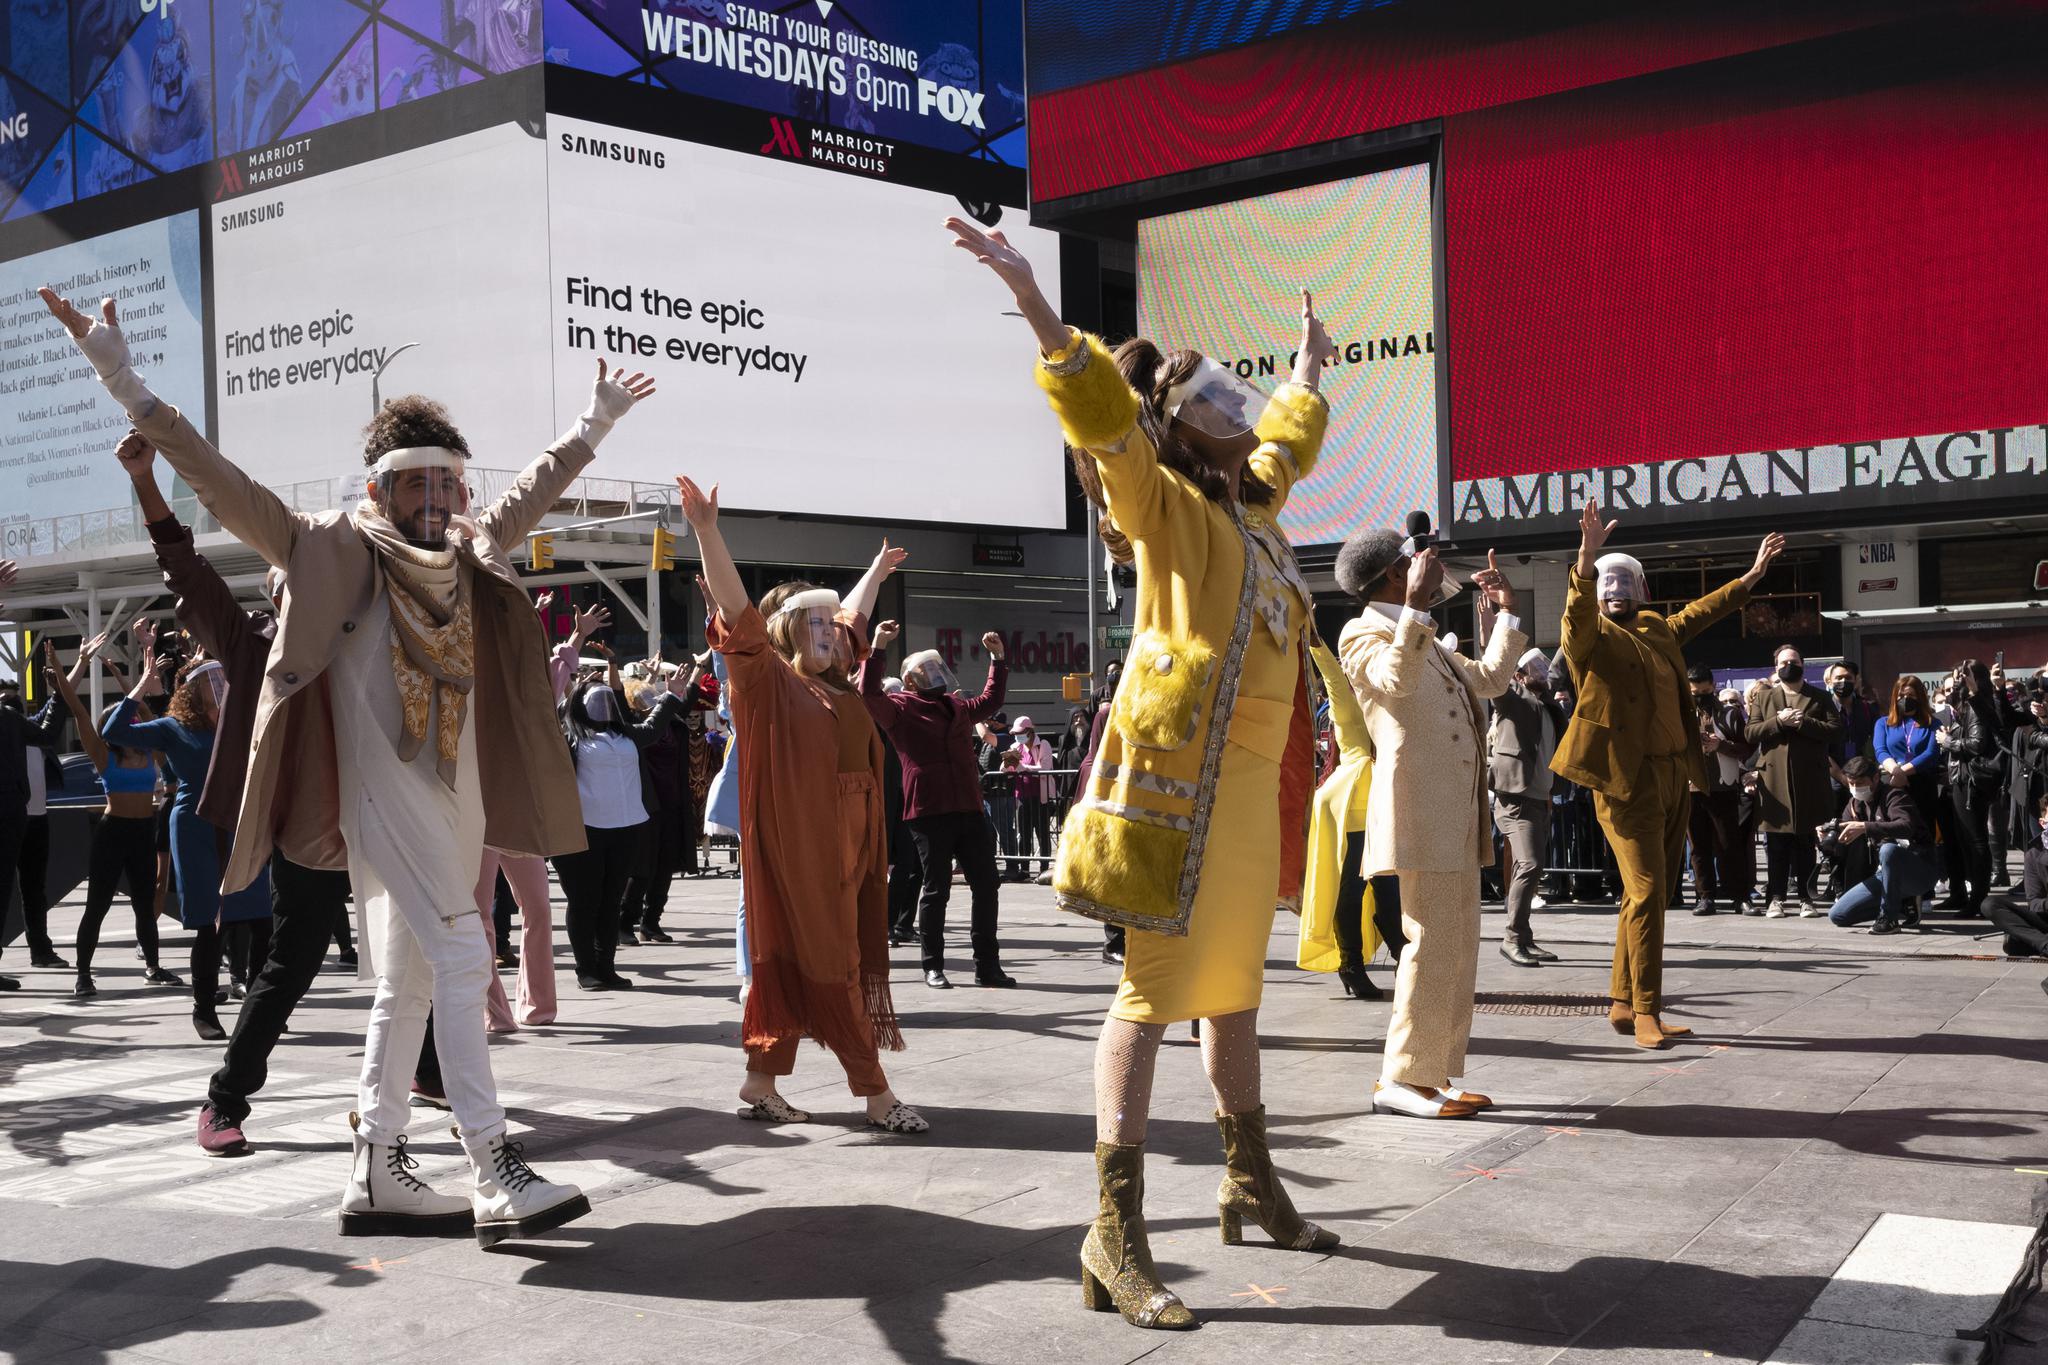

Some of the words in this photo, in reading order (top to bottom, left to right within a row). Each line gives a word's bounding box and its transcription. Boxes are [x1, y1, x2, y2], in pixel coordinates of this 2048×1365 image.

[726, 2, 780, 37] START
[784, 17, 831, 50] YOUR
[836, 31, 918, 72] GUESSING
[641, 8, 847, 96] WEDNESDAYS
[855, 62, 910, 113] 8pm
[918, 78, 986, 130] FOX
[248, 138, 312, 168] MARRIOTT
[561, 132, 667, 169] SAMSUNG
[811, 127, 895, 157] MARRIOTT
[249, 159, 304, 185] MARQUIS
[811, 147, 885, 173] MARQUIS
[221, 201, 284, 232] SAMSUNG
[25, 286, 39, 301] ha
[77, 269, 102, 288] Black
[104, 261, 138, 281] history
[140, 258, 152, 273] by
[8, 311, 18, 327] of
[19, 308, 54, 329] purpos
[119, 285, 135, 300] the
[137, 275, 166, 296] world
[566, 276, 633, 313] Find
[640, 287, 692, 320] the
[700, 299, 765, 334] epic
[4, 333, 32, 350] makes
[34, 332, 45, 344] us
[122, 307, 147, 324] from
[148, 301, 166, 316] the
[225, 326, 265, 359] Find
[269, 323, 303, 349] the
[308, 308, 354, 348] epic
[6, 352, 41, 371] outside.
[43, 346, 67, 363] Black
[567, 317, 596, 350] in
[604, 324, 657, 357] the
[665, 337, 808, 383] everyday
[20, 375, 36, 394] girl
[226, 370, 243, 396] in
[248, 366, 281, 391] the
[285, 346, 387, 386] everyday
[18, 408, 48, 423] Melanie
[57, 397, 96, 416] Campbell
[35, 425, 71, 441] Coalition
[71, 424, 82, 434] on
[83, 418, 102, 432] Black
[27, 450, 47, 464] Black
[1455, 447, 1815, 524] AMERICAN
[1870, 542, 1896, 564] NBA
